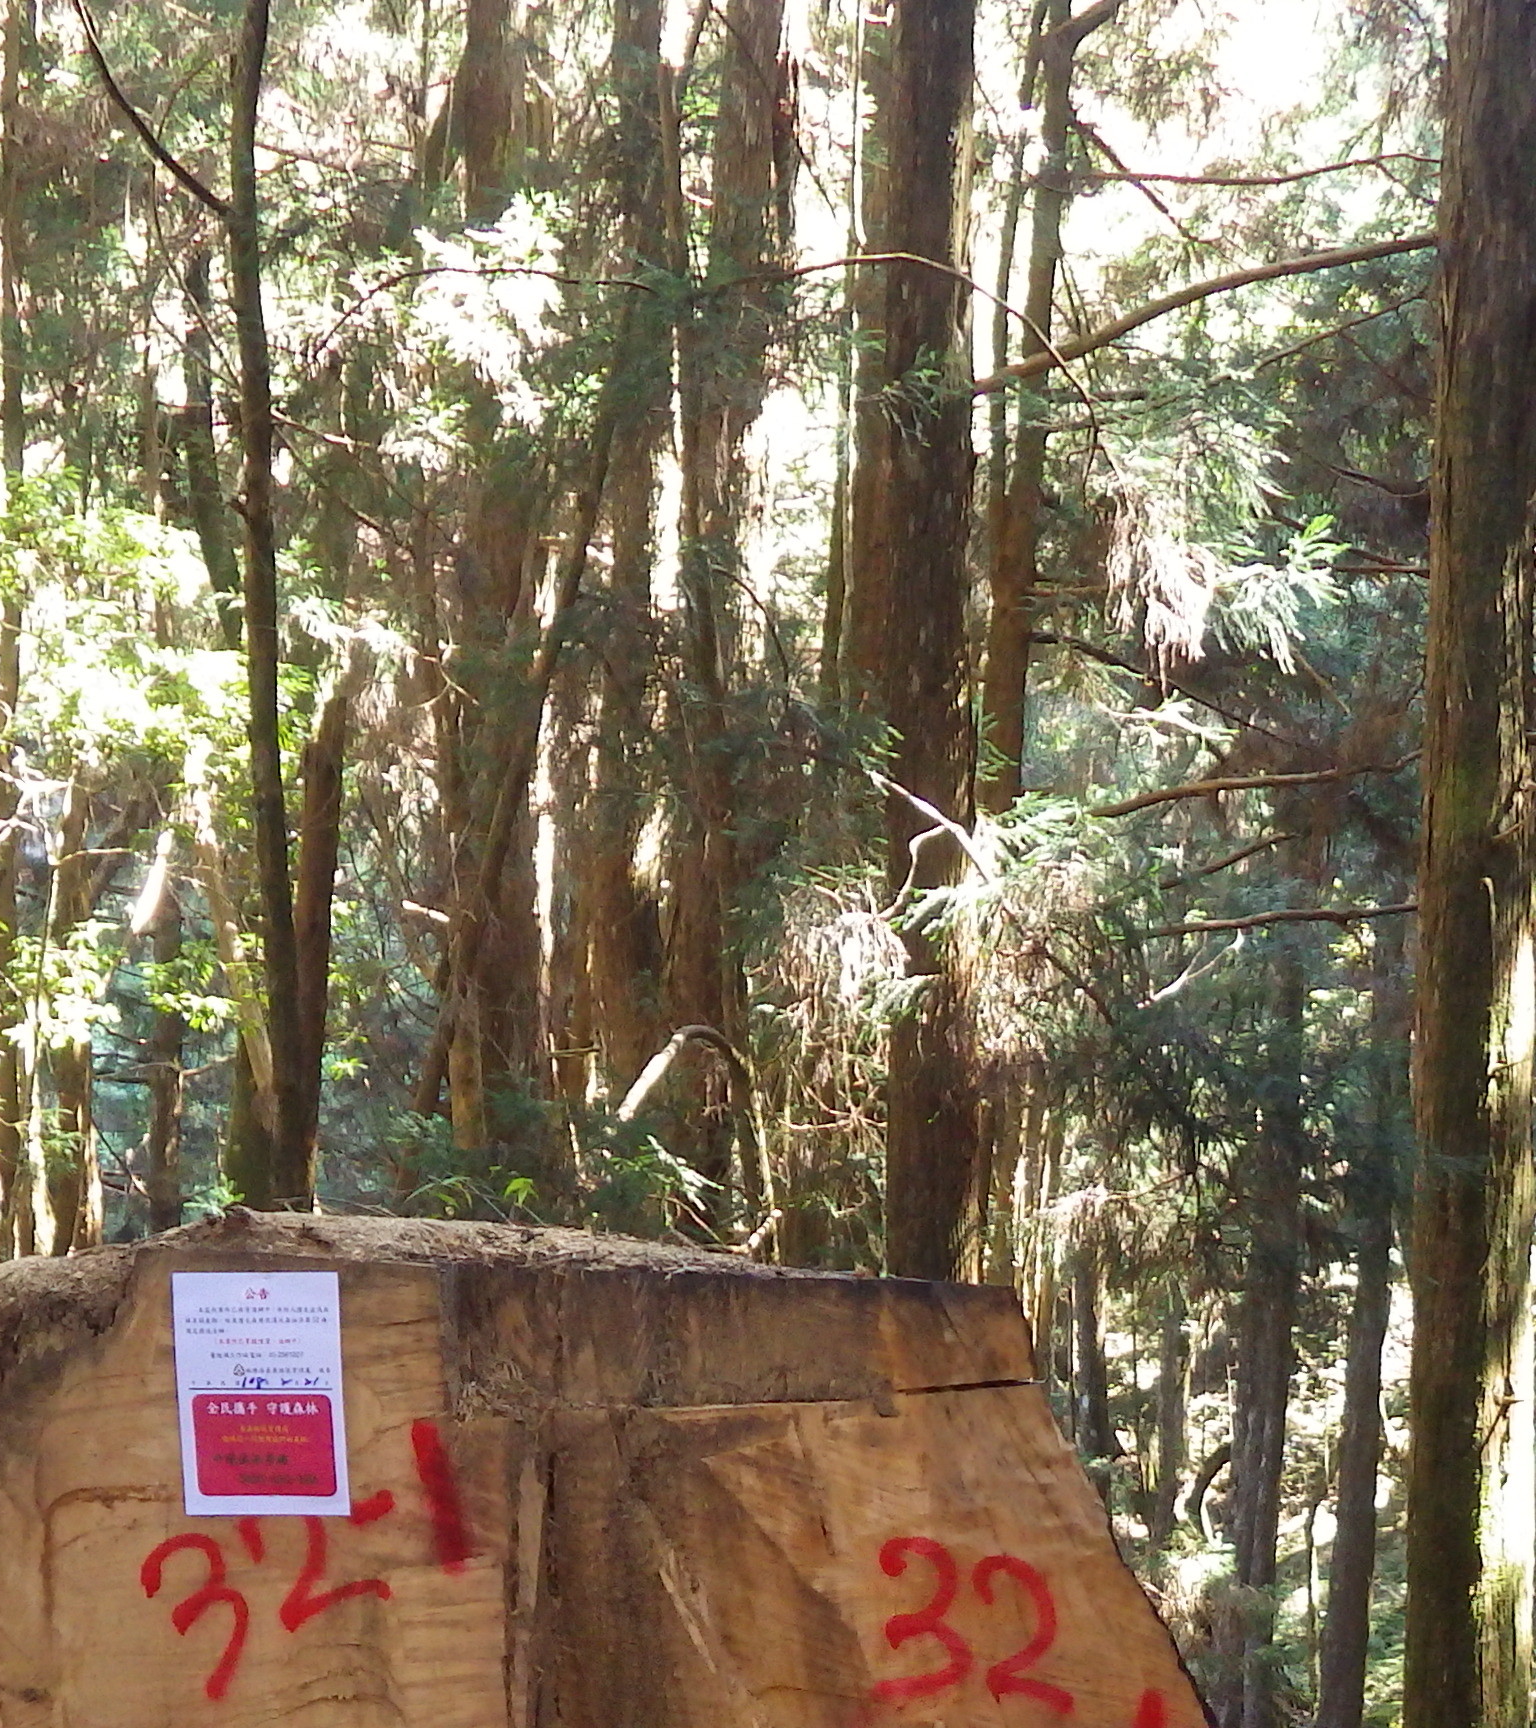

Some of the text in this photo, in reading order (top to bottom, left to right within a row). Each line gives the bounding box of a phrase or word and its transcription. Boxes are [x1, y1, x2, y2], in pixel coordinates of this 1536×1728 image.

[244, 1287, 270, 1300] 公告
[266, 1401, 320, 1417] 守護森林
